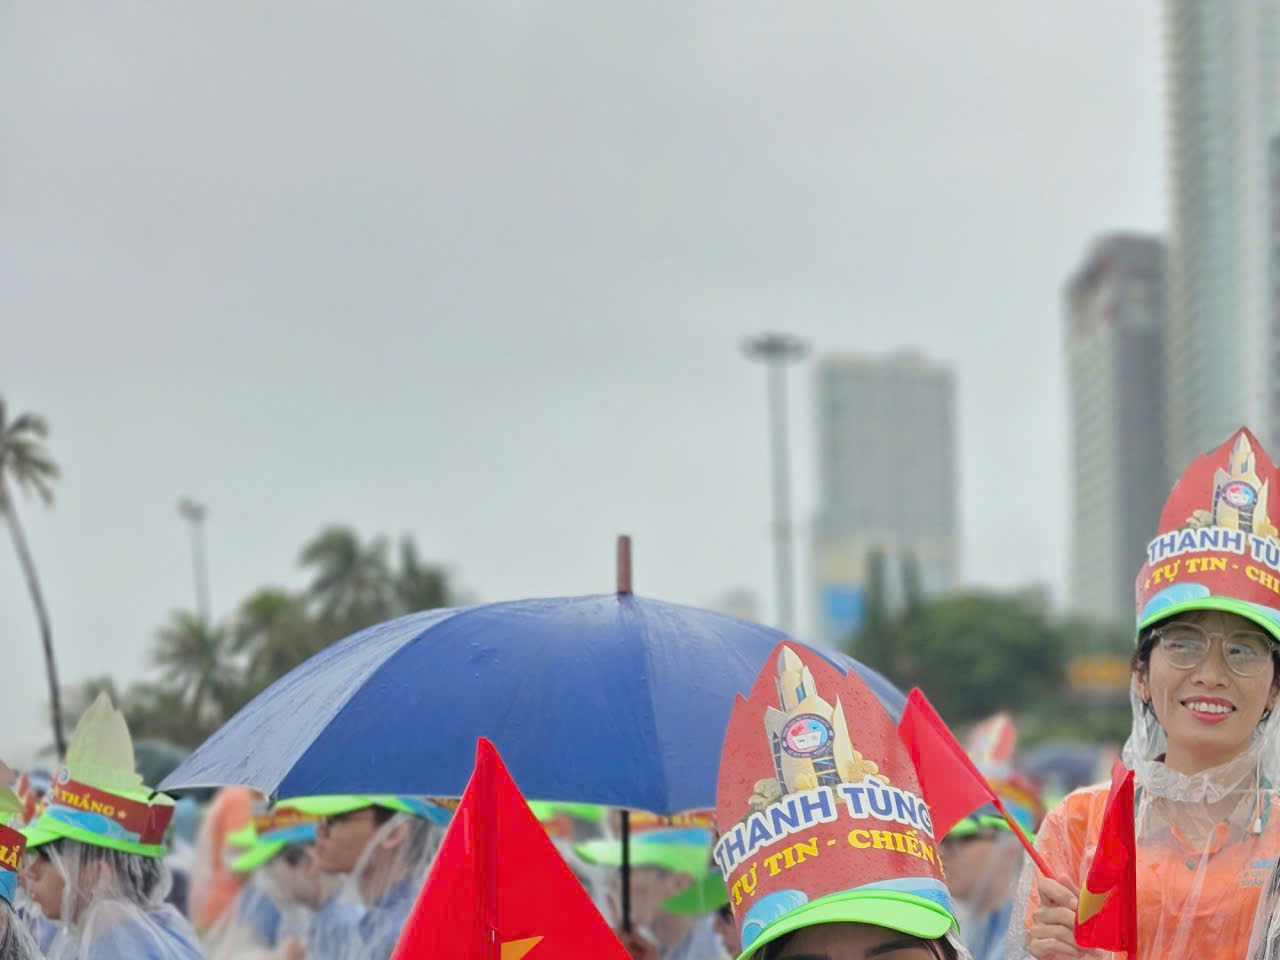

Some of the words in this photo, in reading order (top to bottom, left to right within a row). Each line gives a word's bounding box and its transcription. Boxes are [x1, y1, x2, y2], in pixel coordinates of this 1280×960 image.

[1149, 530, 1242, 563] THANH
[1152, 559, 1181, 582] TỰ
[1185, 557, 1228, 574] TIN
[716, 790, 832, 876] THANH
[842, 779, 935, 839] TÙNG
[731, 862, 759, 905] TỰ
[763, 837, 819, 877] TIN
[847, 829, 937, 865] CHIẾN
